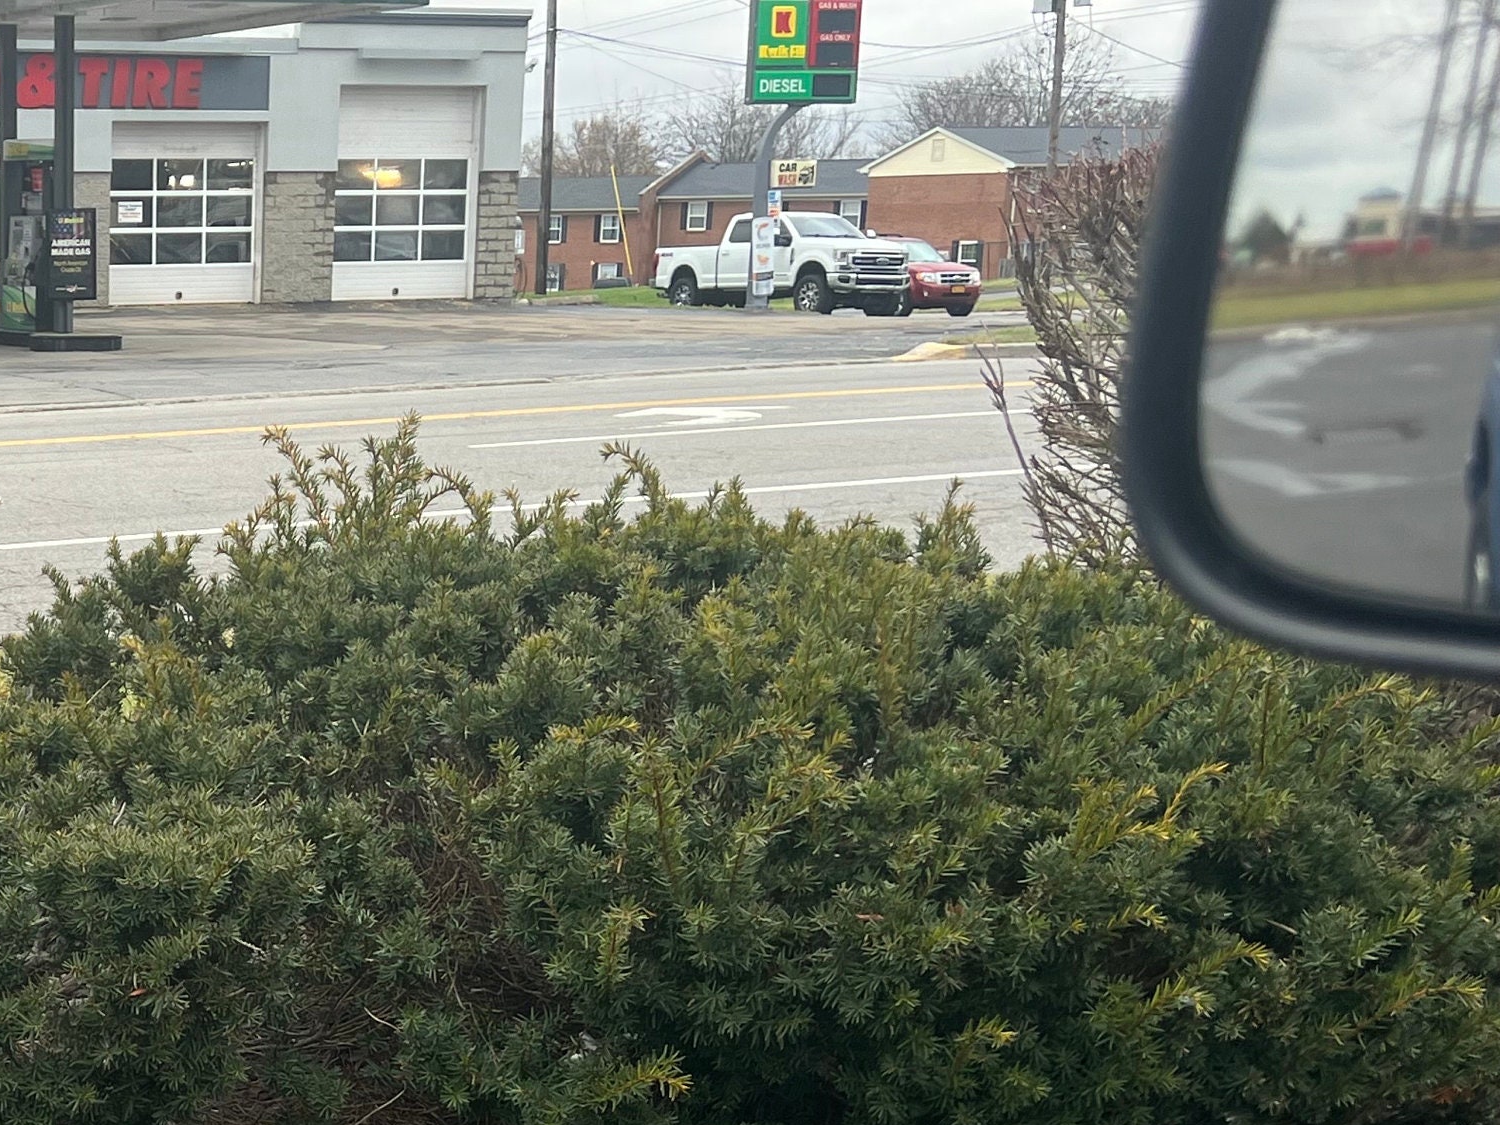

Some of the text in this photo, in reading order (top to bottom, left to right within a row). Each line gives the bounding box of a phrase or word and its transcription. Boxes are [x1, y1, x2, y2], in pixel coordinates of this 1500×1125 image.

[16, 53, 56, 109] &
[78, 58, 204, 109] TIRE
[759, 79, 806, 93] DIESEL
[779, 163, 797, 173] CAR
[778, 173, 797, 186] WASH
[51, 239, 91, 247] AMERICAN
[51, 248, 91, 256] MADE GAS
